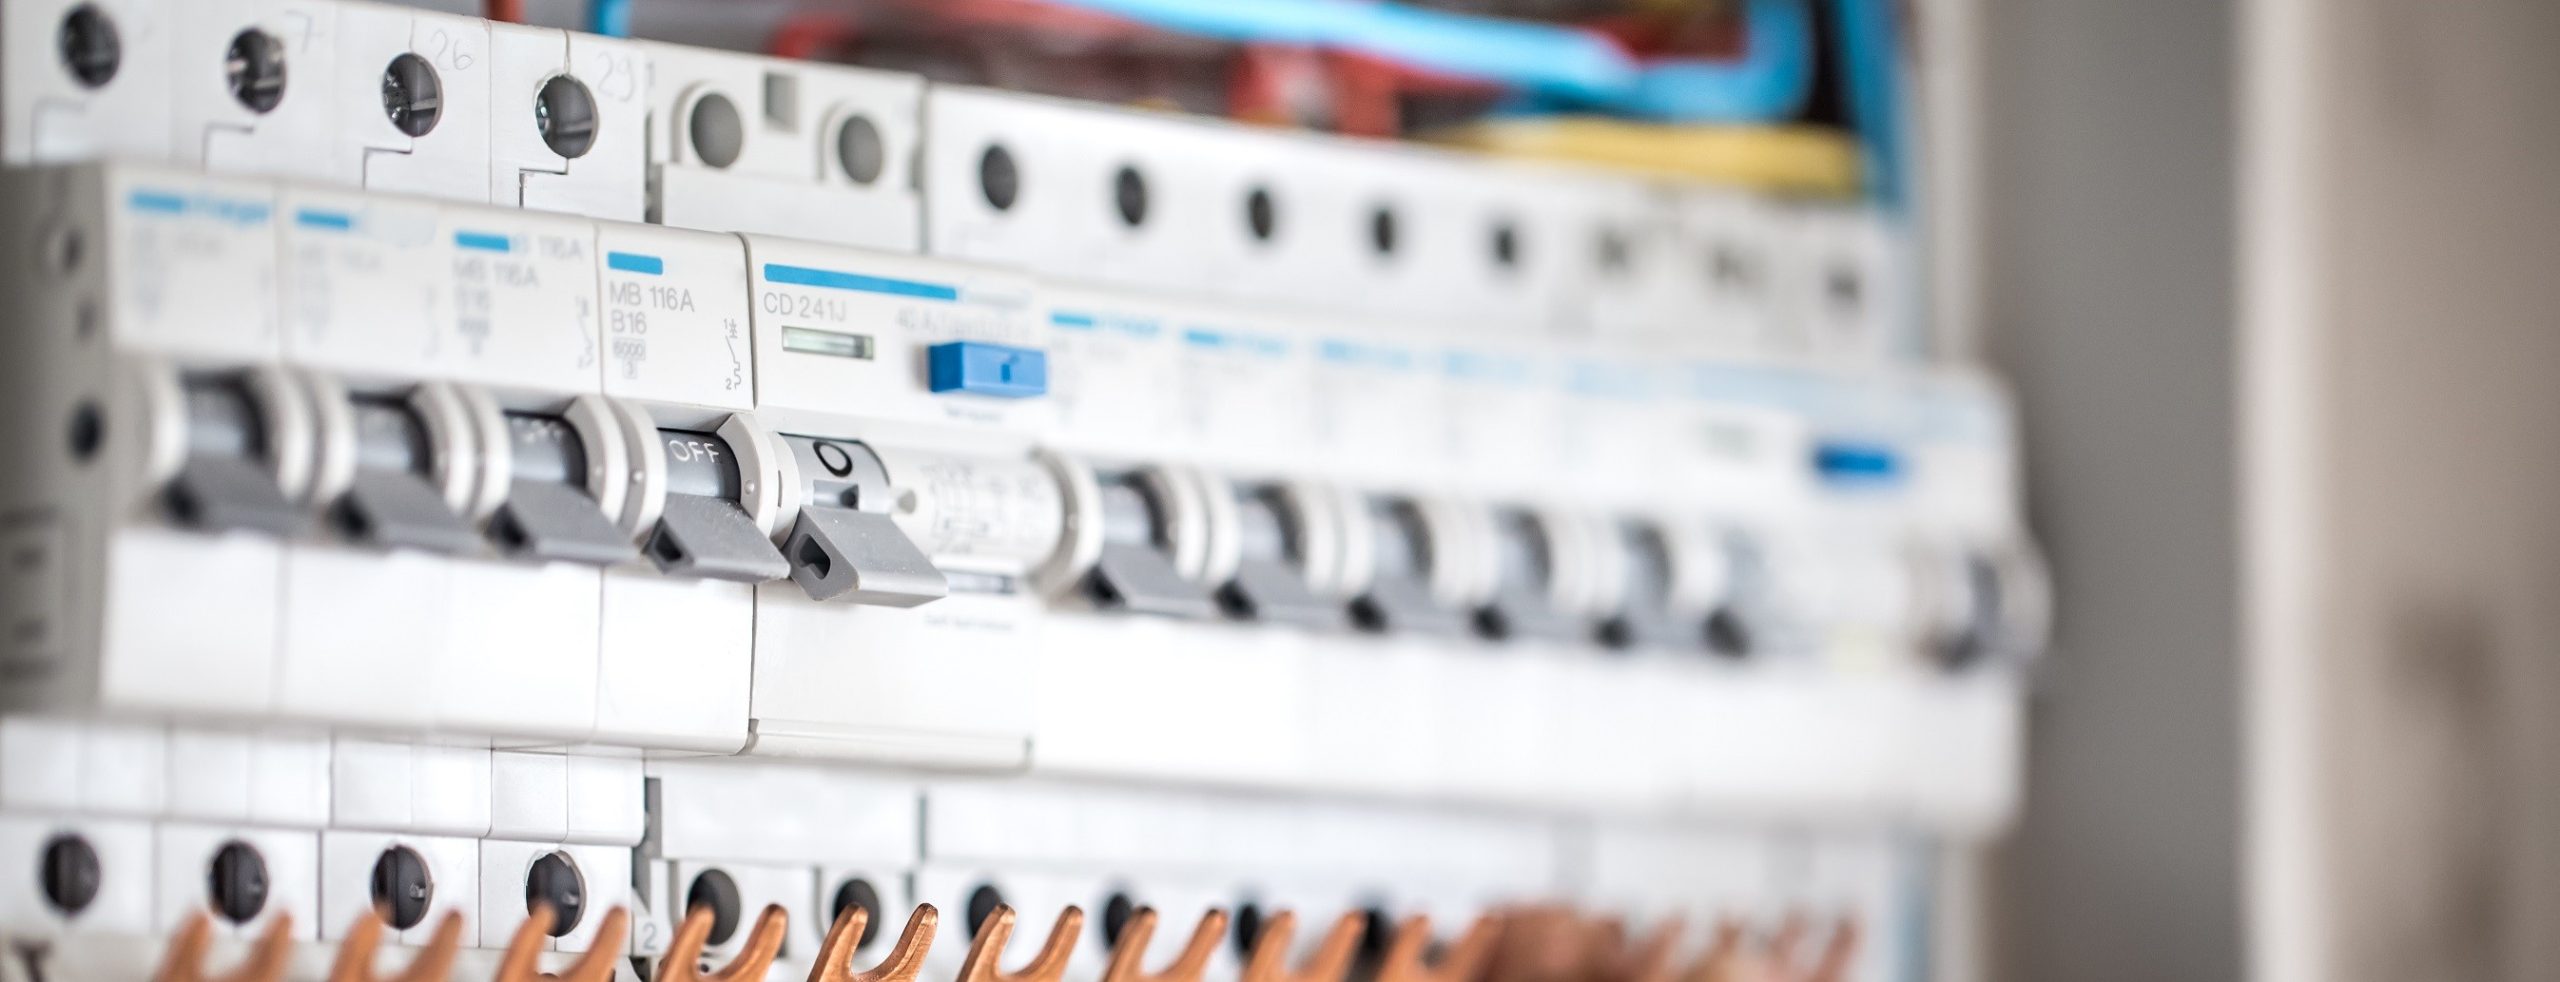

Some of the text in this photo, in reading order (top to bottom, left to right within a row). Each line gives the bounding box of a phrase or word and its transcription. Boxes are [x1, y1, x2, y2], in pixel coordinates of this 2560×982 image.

[430, 28, 474, 71] 26
[597, 50, 635, 102] 29
[609, 281, 695, 312] MB 116A
[764, 291, 847, 322] CD 241J
[611, 312, 647, 335] B16
[613, 340, 644, 360] 6000
[726, 379, 733, 391] 2
[669, 440, 720, 463] OFF
[642, 923, 658, 950] 2
